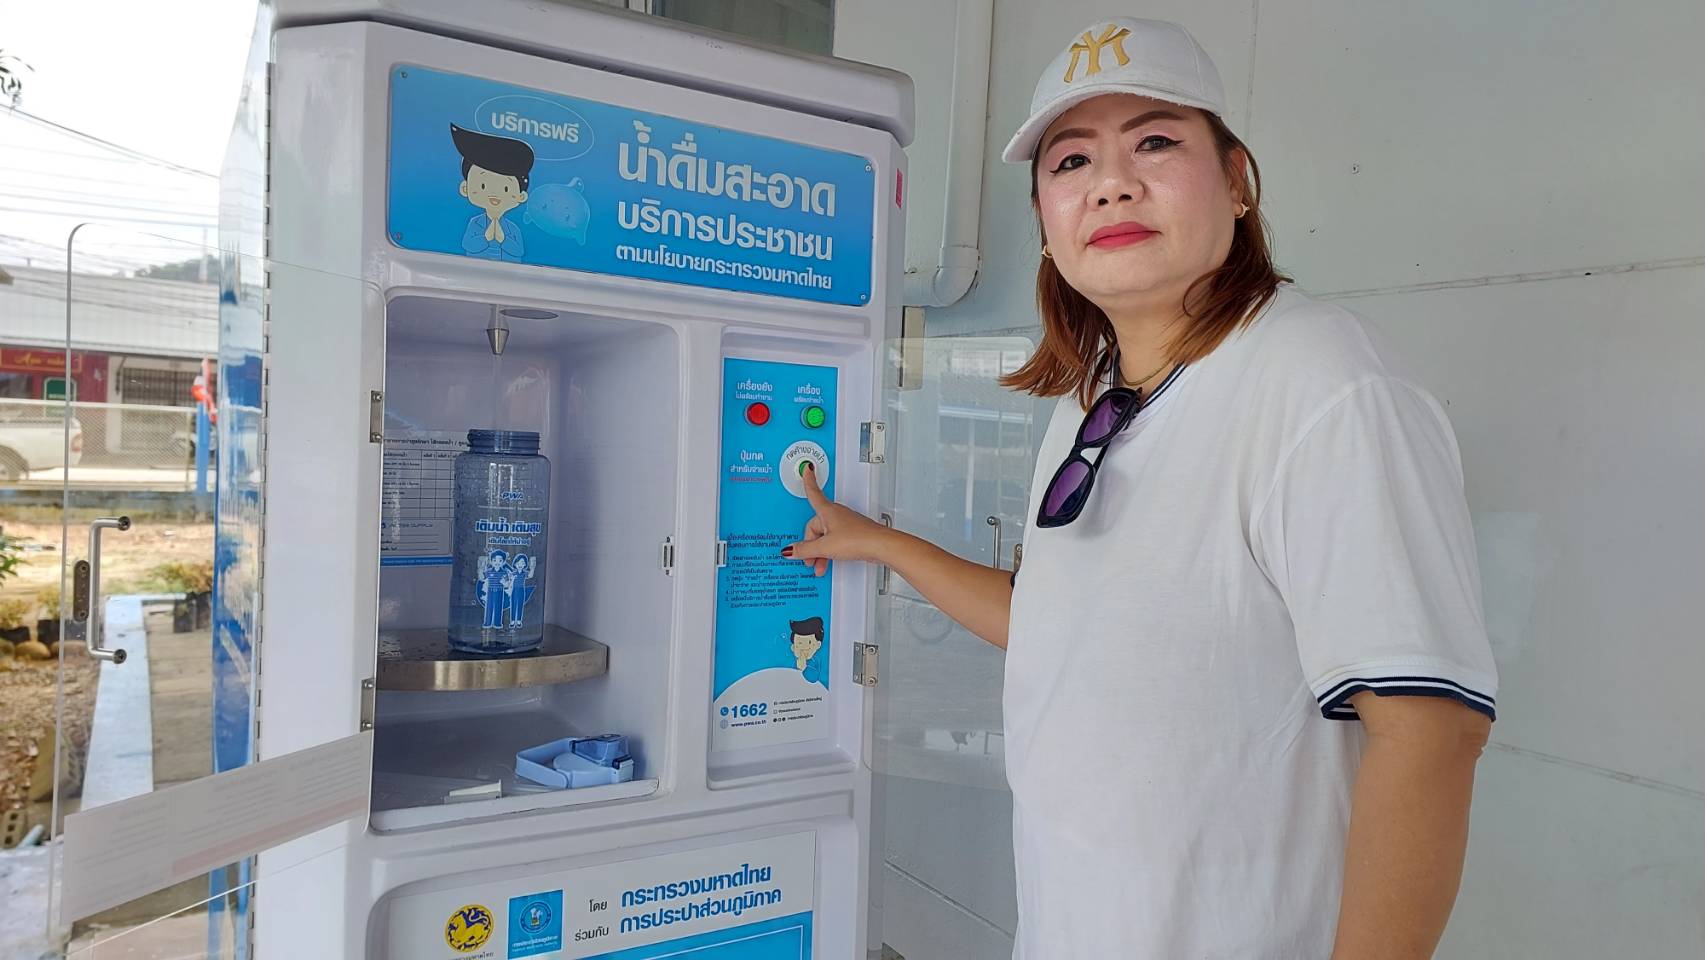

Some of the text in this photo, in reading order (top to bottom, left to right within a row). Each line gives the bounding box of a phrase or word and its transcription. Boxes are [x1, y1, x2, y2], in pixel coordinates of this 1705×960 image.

[491, 111, 580, 144] บริการฟรี
[618, 119, 836, 217] น้ำดื่มสะอาด
[617, 198, 833, 261] บริการประชาชน
[615, 244, 832, 290] ตามนโยบายกระทรวงมหาดไทย
[737, 378, 773, 391] เครื่องยัง
[797, 383, 821, 395] เครื่อง
[730, 463, 773, 473] สำหรับจ่ายน้ำ
[740, 450, 764, 462] ปุ่มกด
[475, 517, 511, 533] เติมน้ำ
[731, 703, 768, 719] 1662
[589, 863, 771, 912] โดย กระทรวงมหาดไทย
[574, 888, 782, 942] ร่วมกับ การประปาส่วนภูมิภาค
